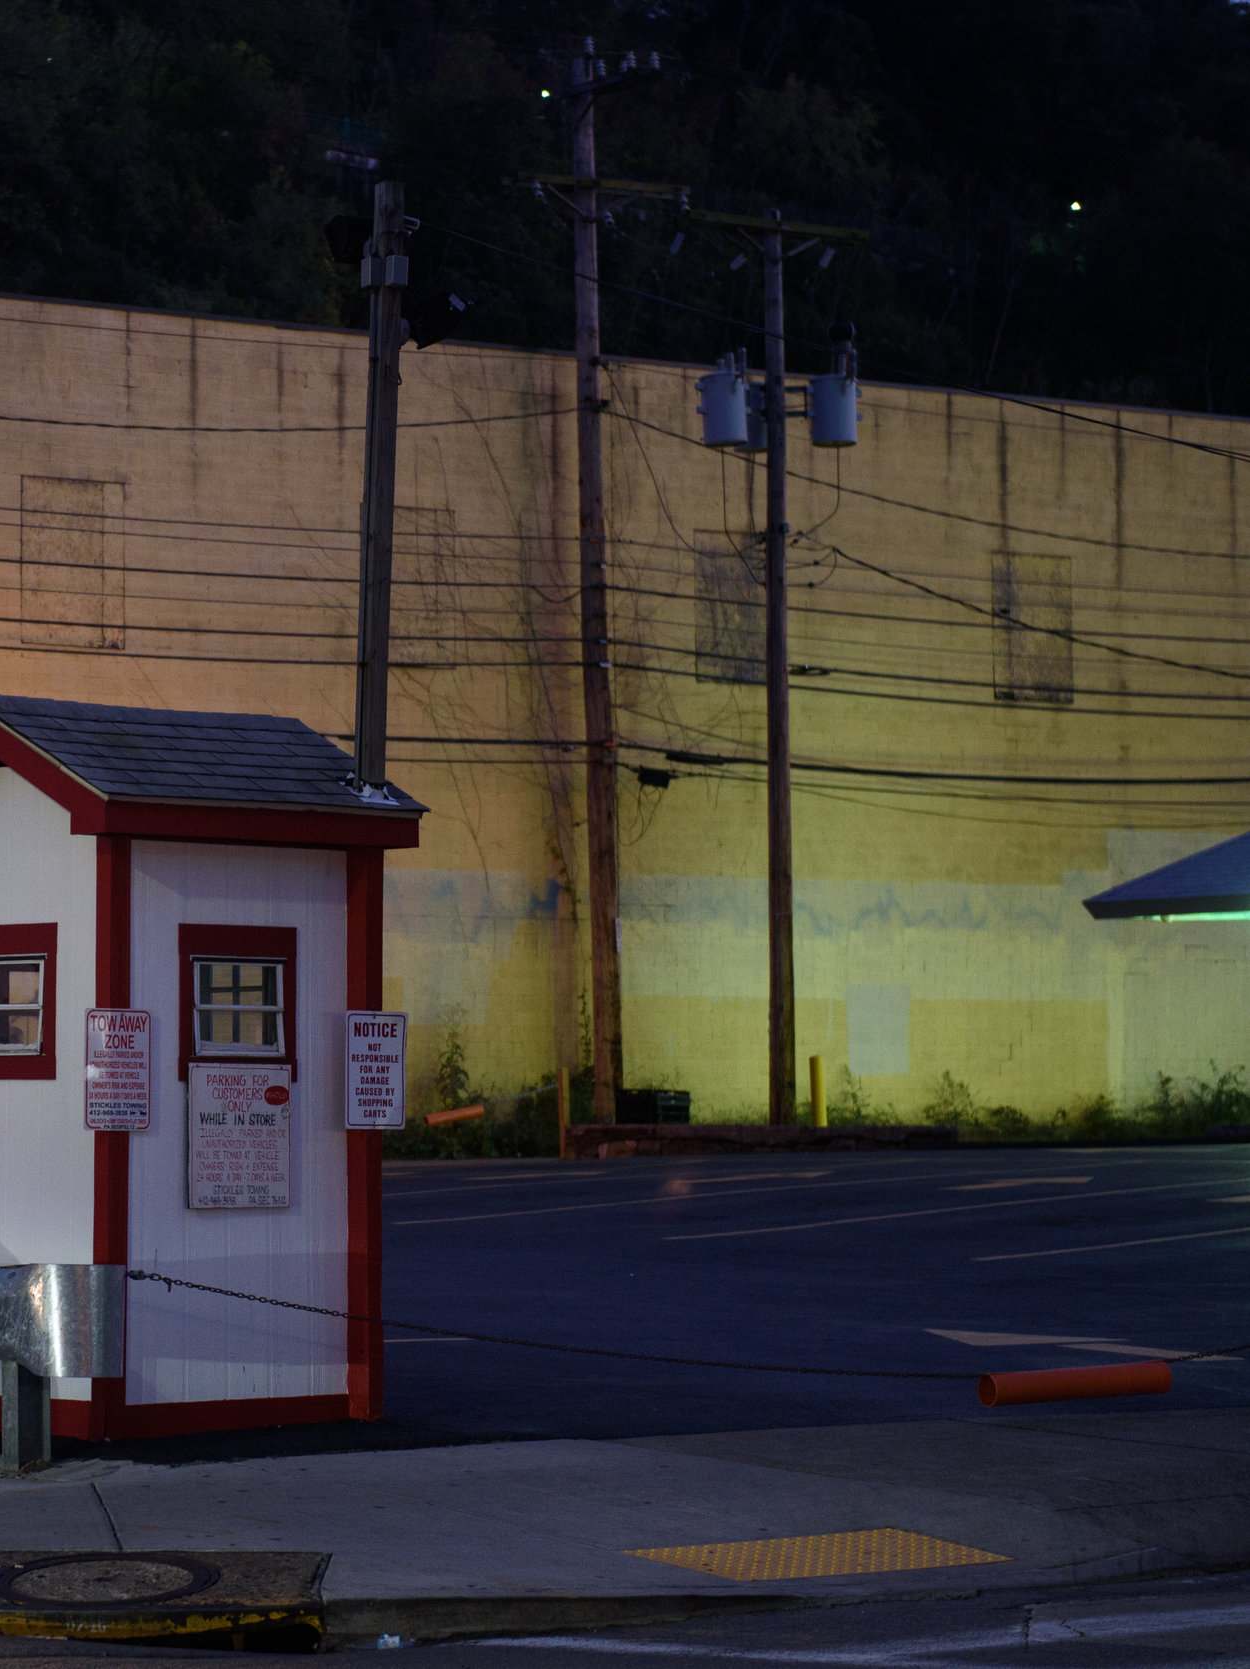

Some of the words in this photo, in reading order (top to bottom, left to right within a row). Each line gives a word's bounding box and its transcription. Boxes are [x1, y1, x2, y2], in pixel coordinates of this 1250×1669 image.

[90, 1015, 117, 1032] TOW
[118, 1015, 148, 1032] AWAY
[354, 1022, 398, 1038] NOTICE
[105, 1034, 135, 1049] ZONE
[368, 1043, 382, 1052] NOT
[351, 1054, 399, 1063] RESPONSIBLE
[360, 1066, 373, 1074] FOR
[376, 1066, 390, 1074] ANY
[206, 1074, 246, 1086] PARKING
[252, 1075, 269, 1086] FOR
[360, 1077, 390, 1085] DAMAGE
[212, 1087, 263, 1100] CUSTOMERS
[355, 1088, 383, 1096] CAUSED
[385, 1088, 395, 1096] BY
[227, 1100, 252, 1112] ONLY
[358, 1098, 393, 1107] SHOPPING
[199, 1112, 227, 1125] WHILE
[234, 1114, 245, 1126] IN
[249, 1114, 276, 1126] STORE
[363, 1110, 387, 1118] CARTS
[199, 1128, 233, 1138] ILLEGALLY
[239, 1128, 263, 1138] PARKED
[202, 1139, 247, 1149] UNAUTHORIZED
[249, 1140, 278, 1149] VEHICLES
[195, 1150, 210, 1160] WILL
[213, 1151, 220, 1160] BE
[223, 1150, 242, 1160] TOWED
[244, 1150, 251, 1160] AT
[254, 1150, 280, 1160] VEHICLE
[229, 1161, 243, 1171] RISK
[252, 1162, 279, 1171] EXPENSE
[197, 1173, 203, 1182] 24
[205, 1173, 224, 1182] HOURS
[226, 1173, 230, 1182] A
[232, 1173, 242, 1182] DAY
[271, 1173, 285, 1182] WEEK
[213, 1185, 244, 1195] STICKLES
[247, 1185, 270, 1195] TOWING
[258, 1196, 270, 1205] SEC
